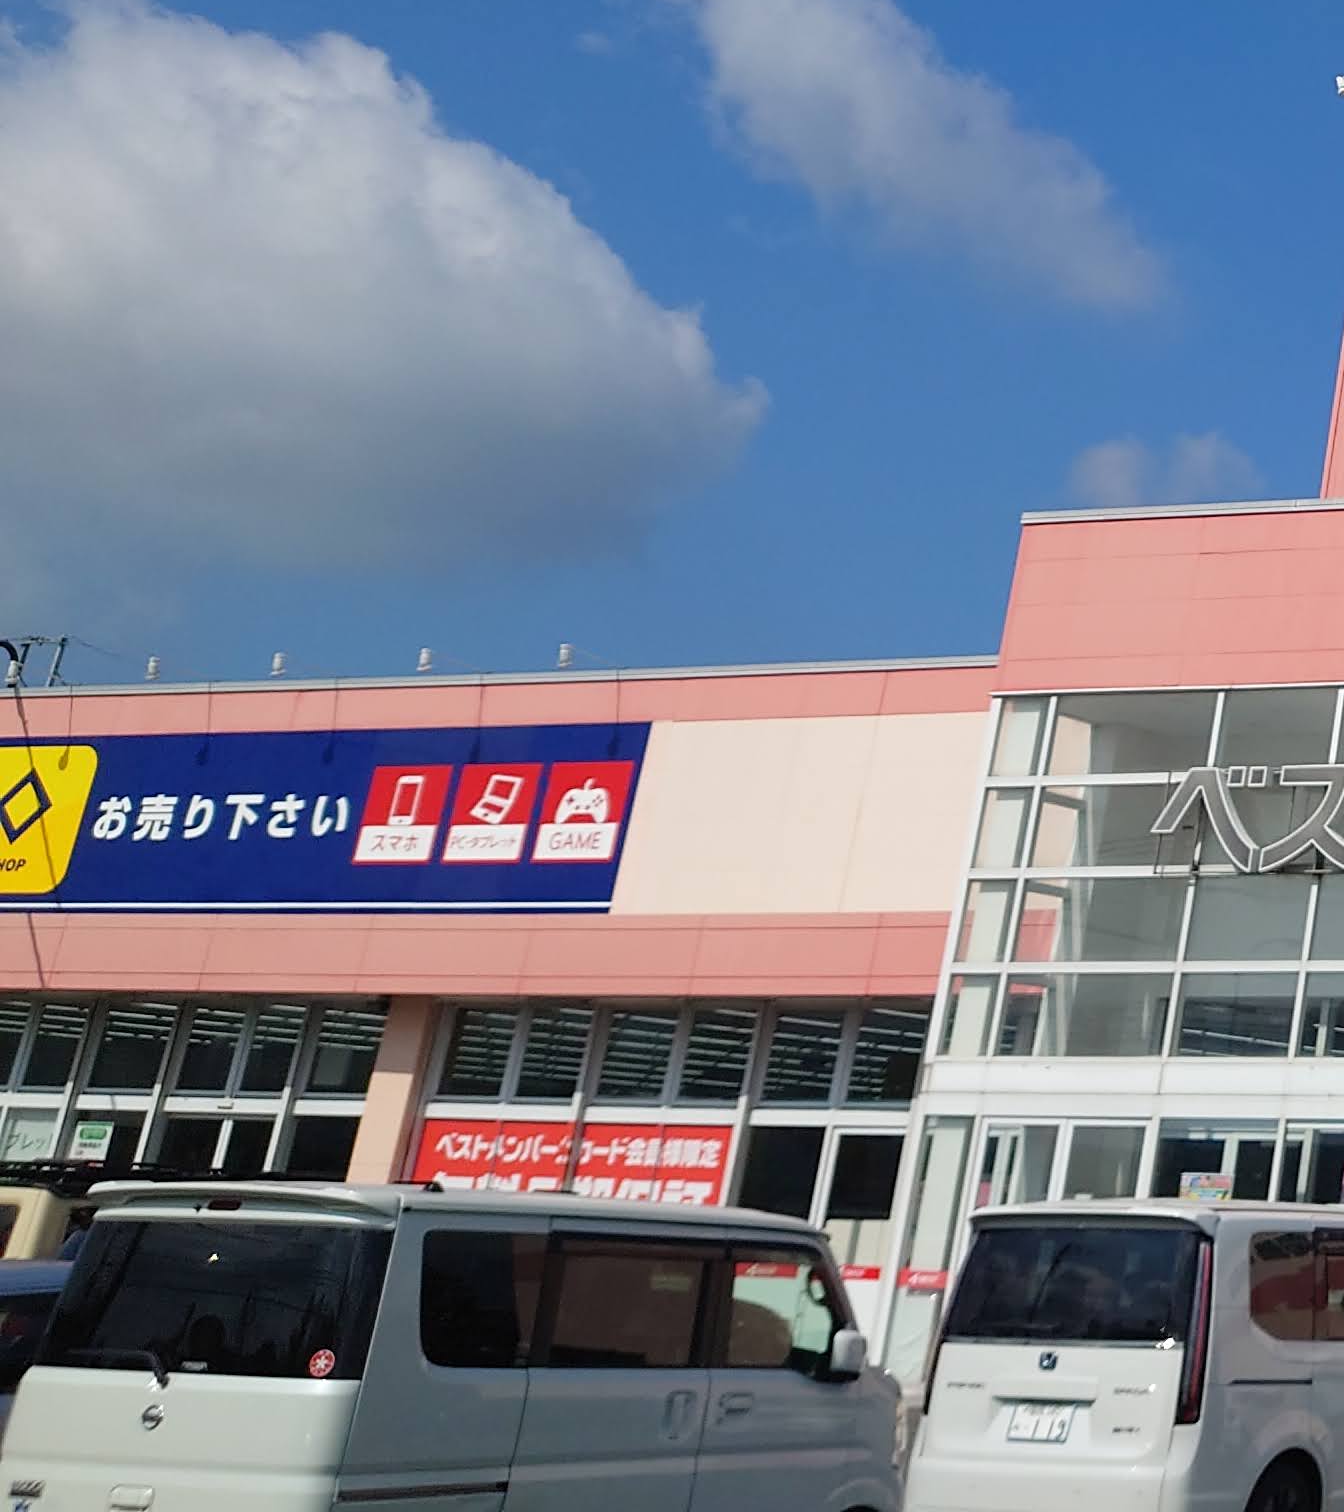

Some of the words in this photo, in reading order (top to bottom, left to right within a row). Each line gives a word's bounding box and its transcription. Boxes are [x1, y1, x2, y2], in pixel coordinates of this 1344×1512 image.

[91, 793, 348, 840] お売り下さい
[370, 833, 418, 852] スマホ
[548, 831, 601, 851] GAME
